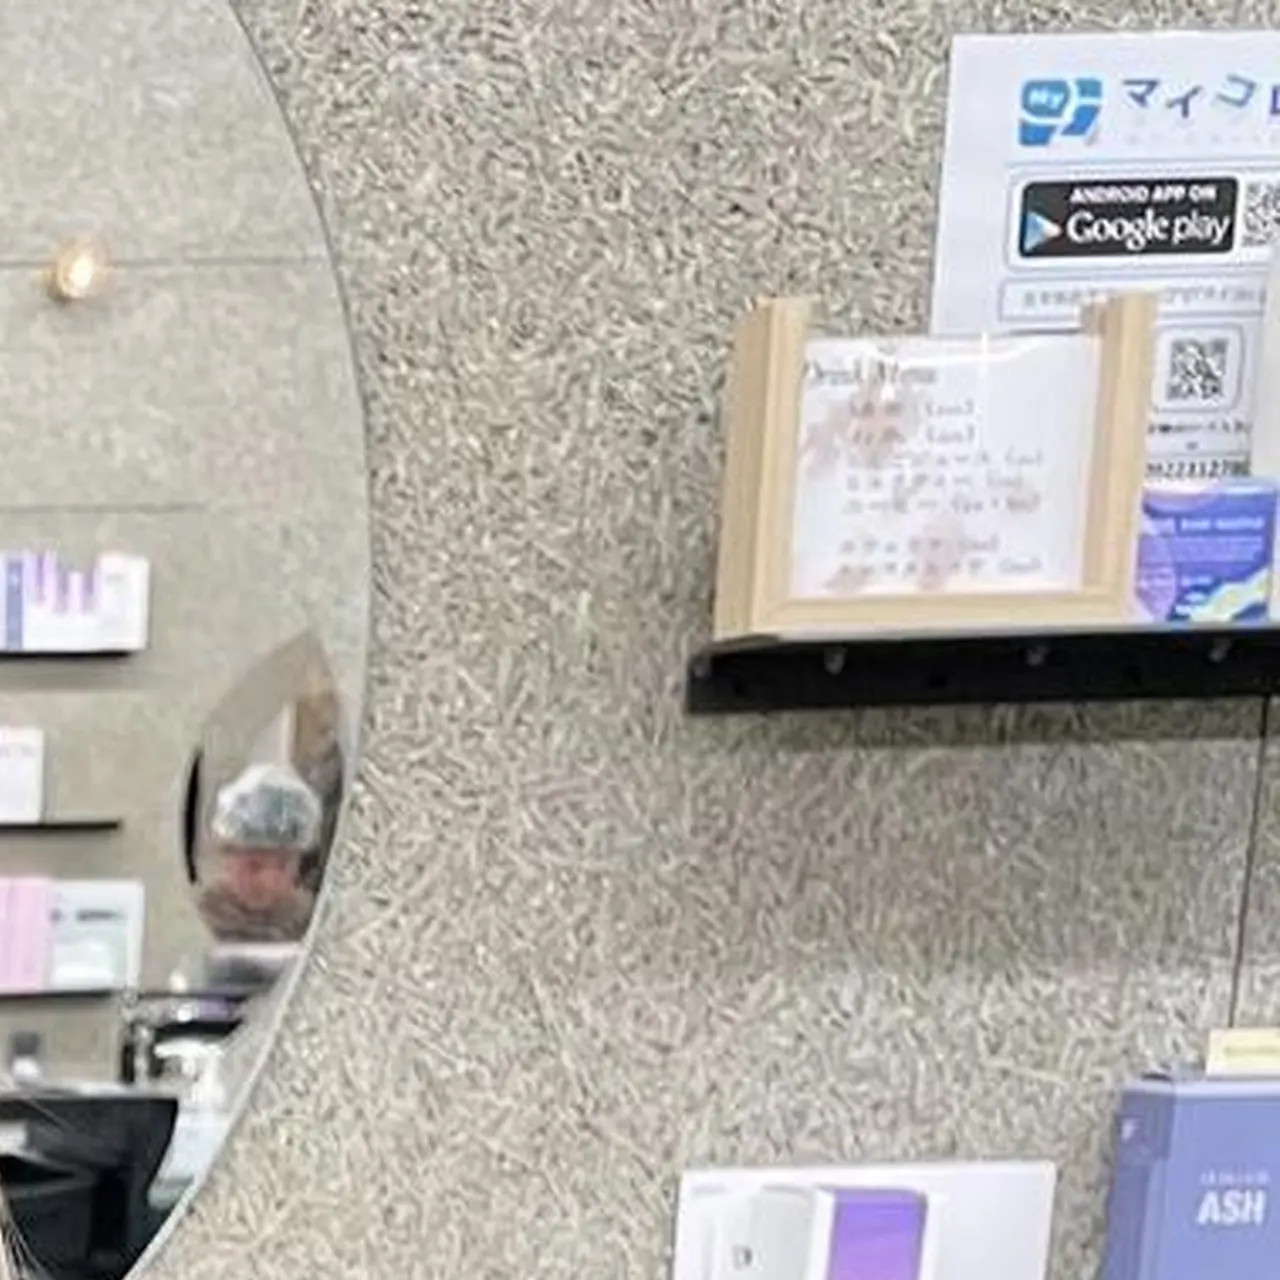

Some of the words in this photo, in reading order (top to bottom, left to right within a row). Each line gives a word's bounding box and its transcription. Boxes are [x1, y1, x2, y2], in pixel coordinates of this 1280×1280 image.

[1151, 185, 1184, 203] APP
[1066, 207, 1169, 251] Google
[1171, 210, 1231, 245] play
[1196, 1188, 1267, 1227] ASH
